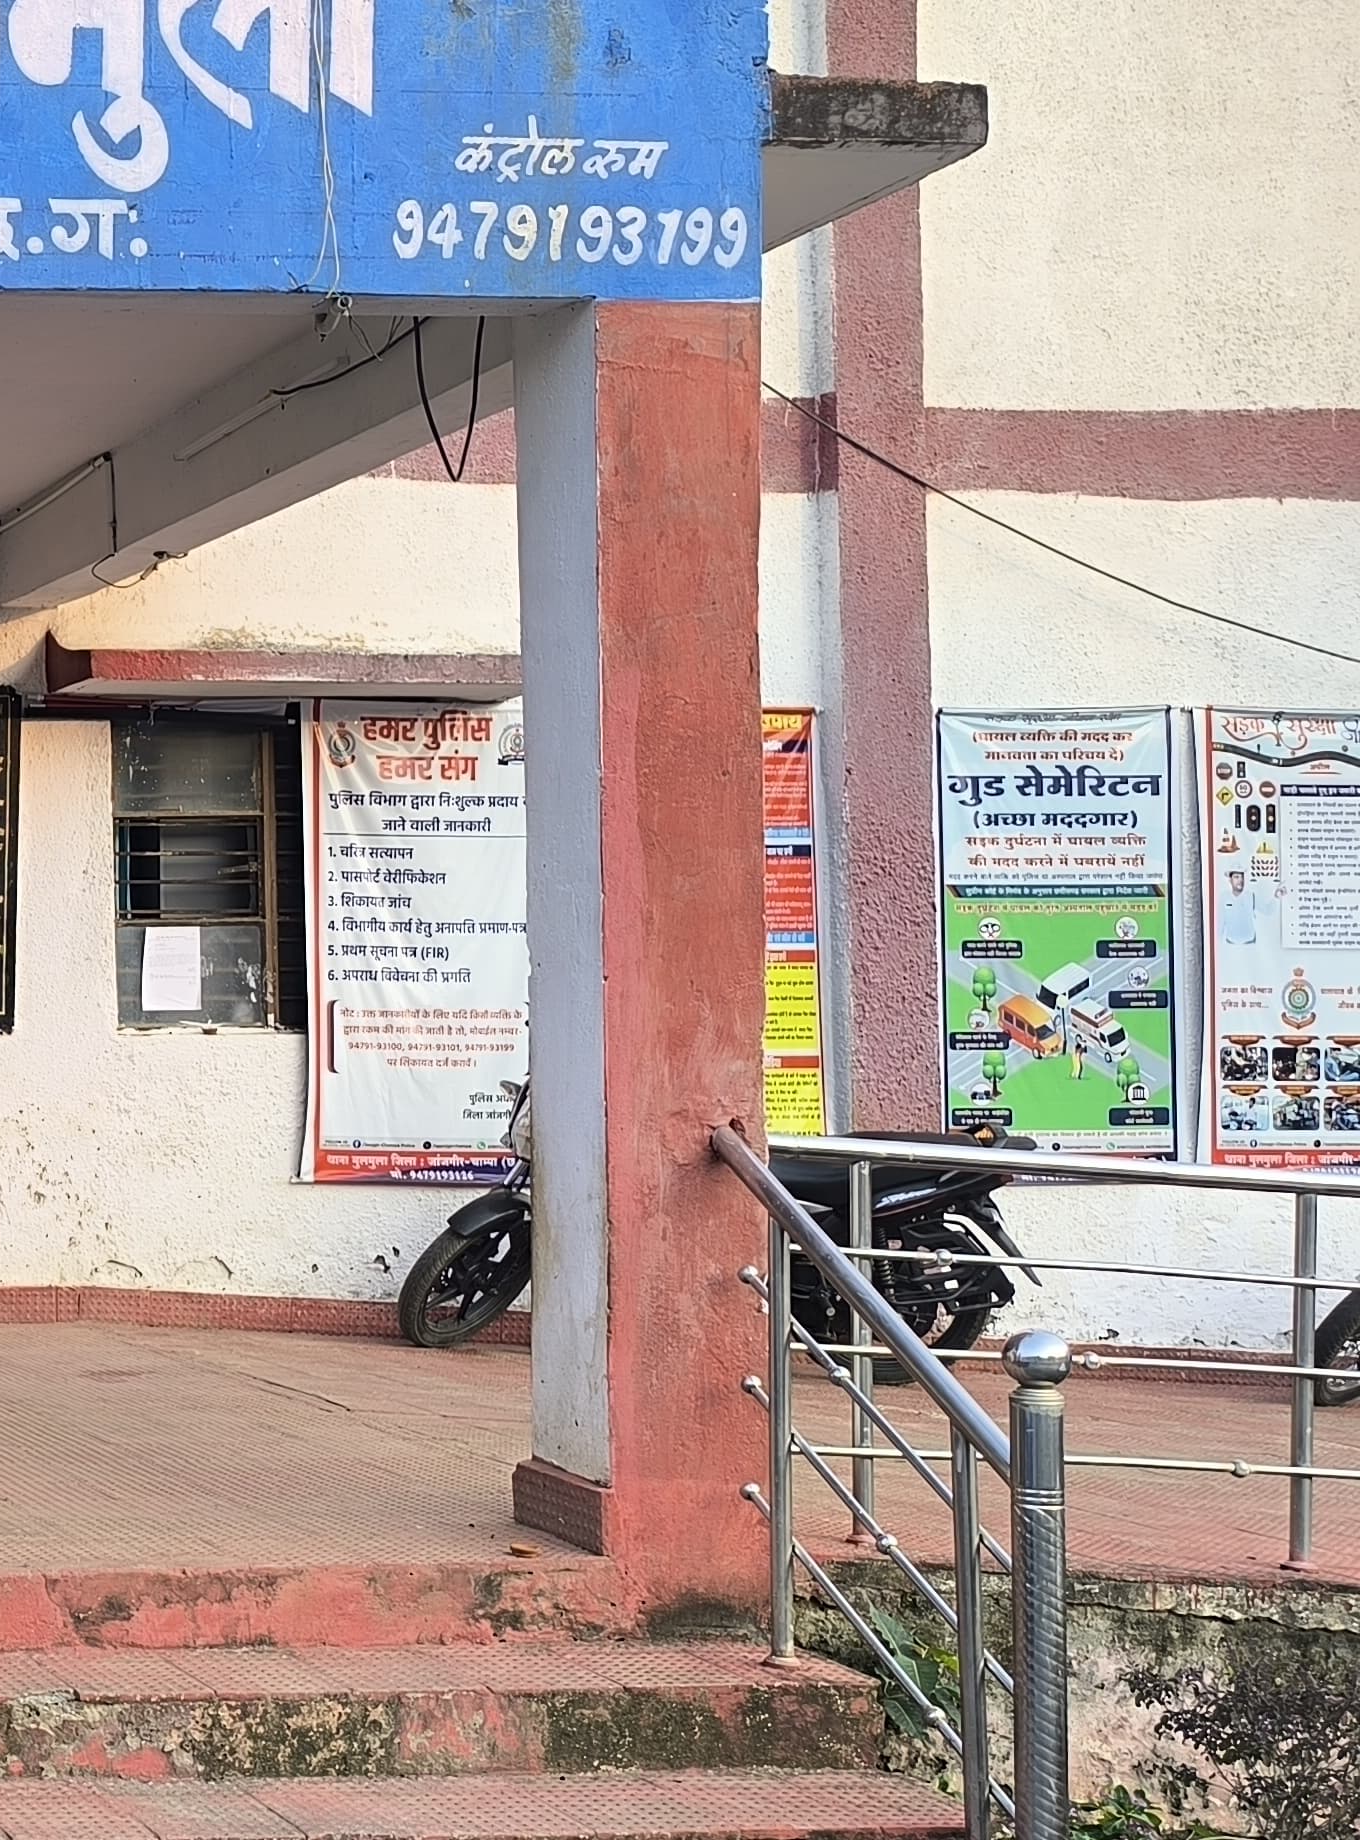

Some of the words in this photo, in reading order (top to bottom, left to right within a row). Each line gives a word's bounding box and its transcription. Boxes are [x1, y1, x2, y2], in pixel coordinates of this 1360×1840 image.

[455, 115, 584, 183] कंट्रोल
[393, 199, 748, 269] 9479193199
[360, 716, 418, 741] हमर
[423, 709, 493, 750] पुलिस
[1020, 729, 1055, 743] व्यक्ति
[1060, 729, 1078, 743] की
[1081, 732, 1109, 743] मदद
[1038, 750, 1058, 761] का
[1062, 748, 1105, 761] परिचय
[376, 754, 435, 780] हमर
[438, 750, 478, 781] संग
[947, 774, 1006, 806] गुड
[1014, 765, 1162, 797] सेमेरिटन
[328, 790, 364, 809] पुलिस
[368, 791, 407, 807] विभाग
[410, 795, 435, 811] द्वारा
[439, 793, 485, 812] निःशुल्क
[488, 795, 518, 808] प्रदाय
[382, 816, 406, 832] जाने
[409, 816, 440, 832] वाली
[443, 816, 491, 833] जानकारी
[973, 810, 1035, 829] (अच्छा
[1041, 810, 1138, 828] मददगार)
[1004, 833, 1047, 850] दुर्घटना
[1051, 833, 1062, 847] में
[1067, 836, 1105, 846] घायल
[1111, 833, 1146, 847] व्यक्ति
[328, 846, 337, 858] 1.
[339, 842, 366, 860] चरित्र
[368, 847, 414, 860] सत्यापन
[968, 854, 987, 867] की
[991, 857, 1019, 868] मदद
[1024, 853, 1053, 868] करने
[1059, 853, 1070, 867] में
[1120, 853, 1145, 867] नहीं
[328, 871, 338, 883] 2.
[341, 868, 381, 884] पासपोर्ट
[383, 868, 446, 885] वेरीफिकेशन
[328, 895, 338, 907] 3.
[340, 892, 385, 908] शिकायत
[387, 893, 412, 909] जांच
[328, 920, 339, 932] 4.
[342, 917, 386, 933] विभागीय
[388, 918, 413, 934] कार्य
[415, 918, 432, 937] हेतु
[435, 919, 475, 935] अनापत्ति
[328, 945, 339, 956] 5.
[341, 945, 368, 959] प्रथम
[370, 945, 398, 961] सूचना
[400, 946, 417, 959] पत्र
[420, 946, 449, 961] (FIR)
[328, 969, 339, 981] 6.
[342, 969, 378, 982] अपराध
[381, 967, 419, 983] विवेचना
[422, 968, 438, 982] की
[441, 968, 471, 984] प्रगति
[381, 1024, 394, 1034] की
[387, 1058, 397, 1067] पर
[469, 1092, 493, 1105] पुलिस
[463, 1109, 482, 1120] जिला
[327, 1154, 349, 1165] थाना
[351, 1155, 388, 1169] मुलमुला
[391, 1152, 417, 1166] जिला
